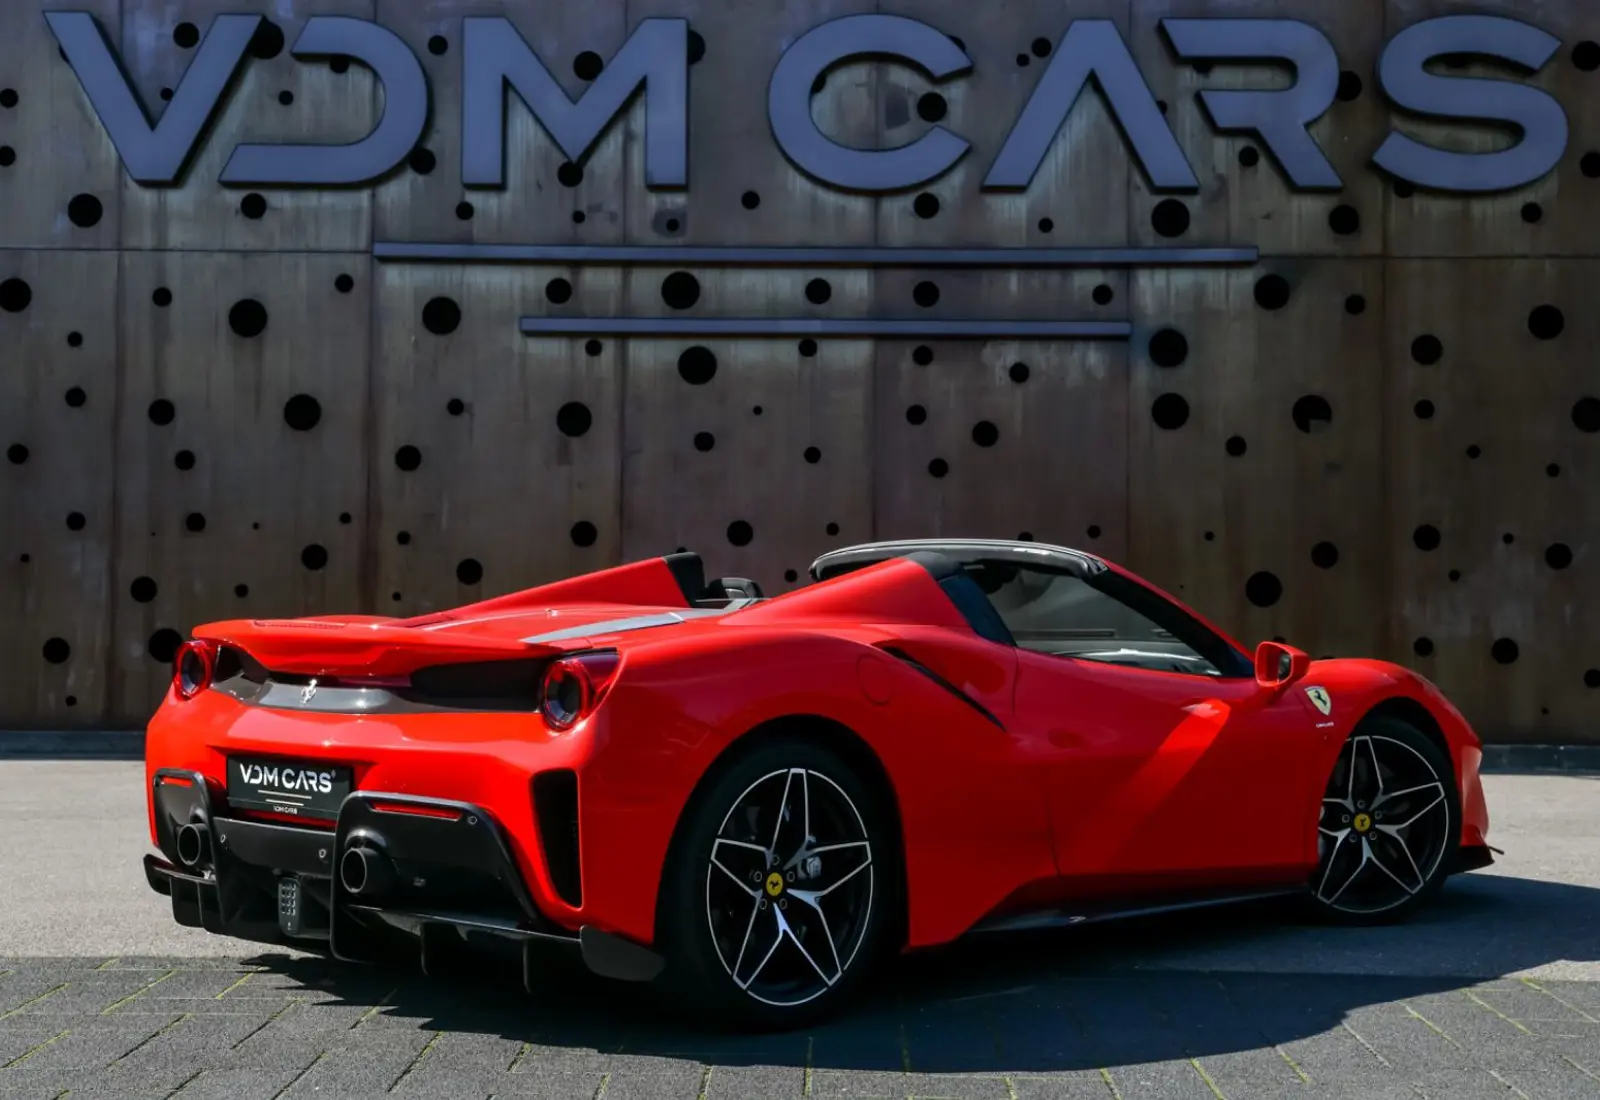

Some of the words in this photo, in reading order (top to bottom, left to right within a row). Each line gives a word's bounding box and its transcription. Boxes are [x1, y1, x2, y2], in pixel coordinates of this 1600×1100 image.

[43, 11, 689, 188] VDM
[767, 13, 1569, 192] CARS
[240, 763, 278, 787] VDM
